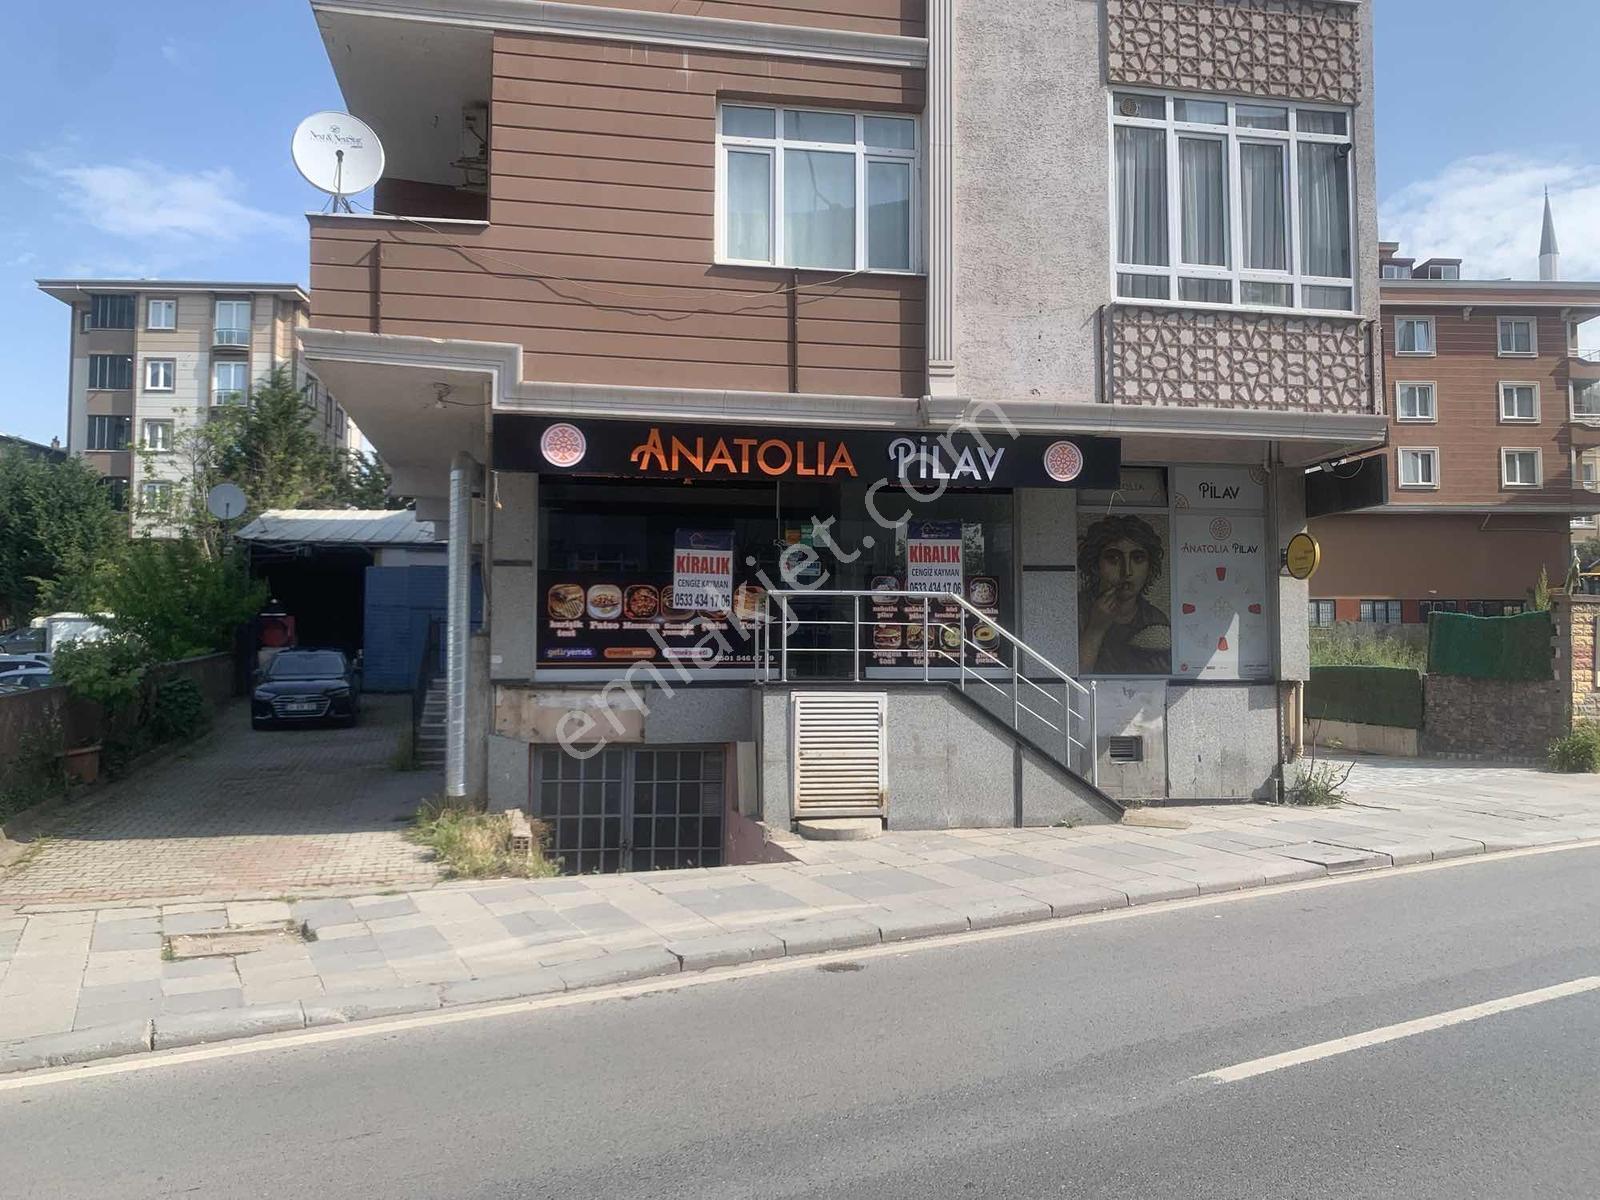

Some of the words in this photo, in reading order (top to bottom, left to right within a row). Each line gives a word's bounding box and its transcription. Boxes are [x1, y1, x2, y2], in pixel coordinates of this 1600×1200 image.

[630, 428, 858, 477] ANATOLIA
[909, 543, 960, 563] KİRALIK
[1181, 543, 1229, 553] ANATOLIA
[676, 552, 730, 575] KİRALIK
[934, 567, 960, 577] KAYMAN
[674, 592, 693, 606] 0533
[694, 593, 708, 607] 434
[710, 594, 719, 608] 17
